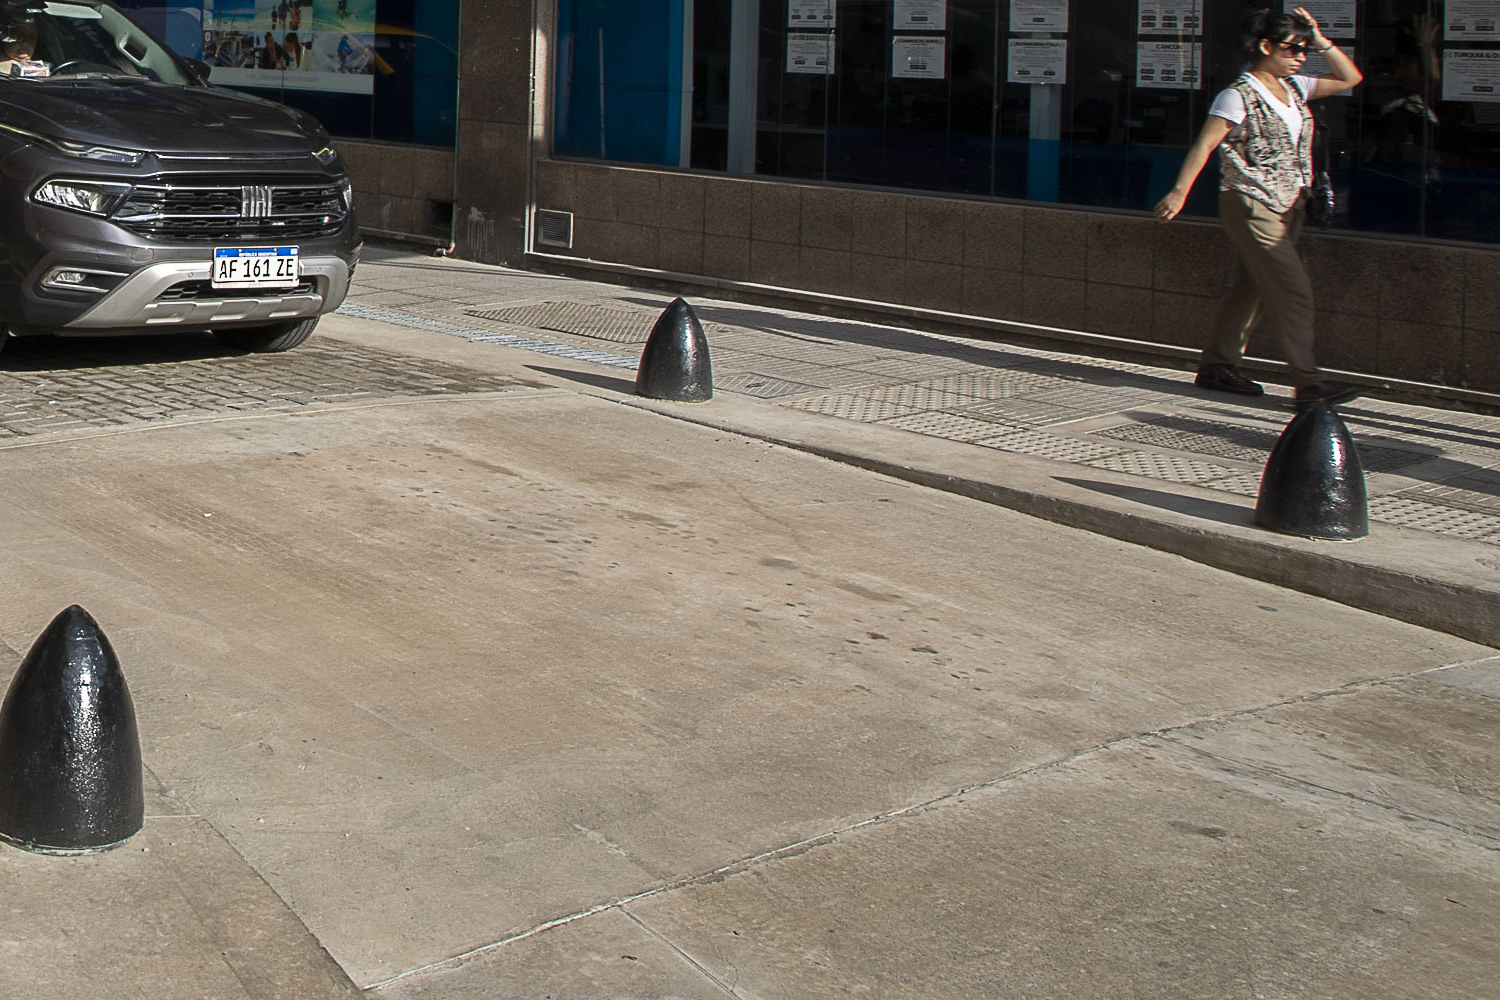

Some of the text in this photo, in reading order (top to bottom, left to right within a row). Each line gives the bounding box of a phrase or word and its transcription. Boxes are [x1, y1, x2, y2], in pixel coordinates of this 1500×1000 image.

[219, 258, 294, 279] AF 161 ZE
